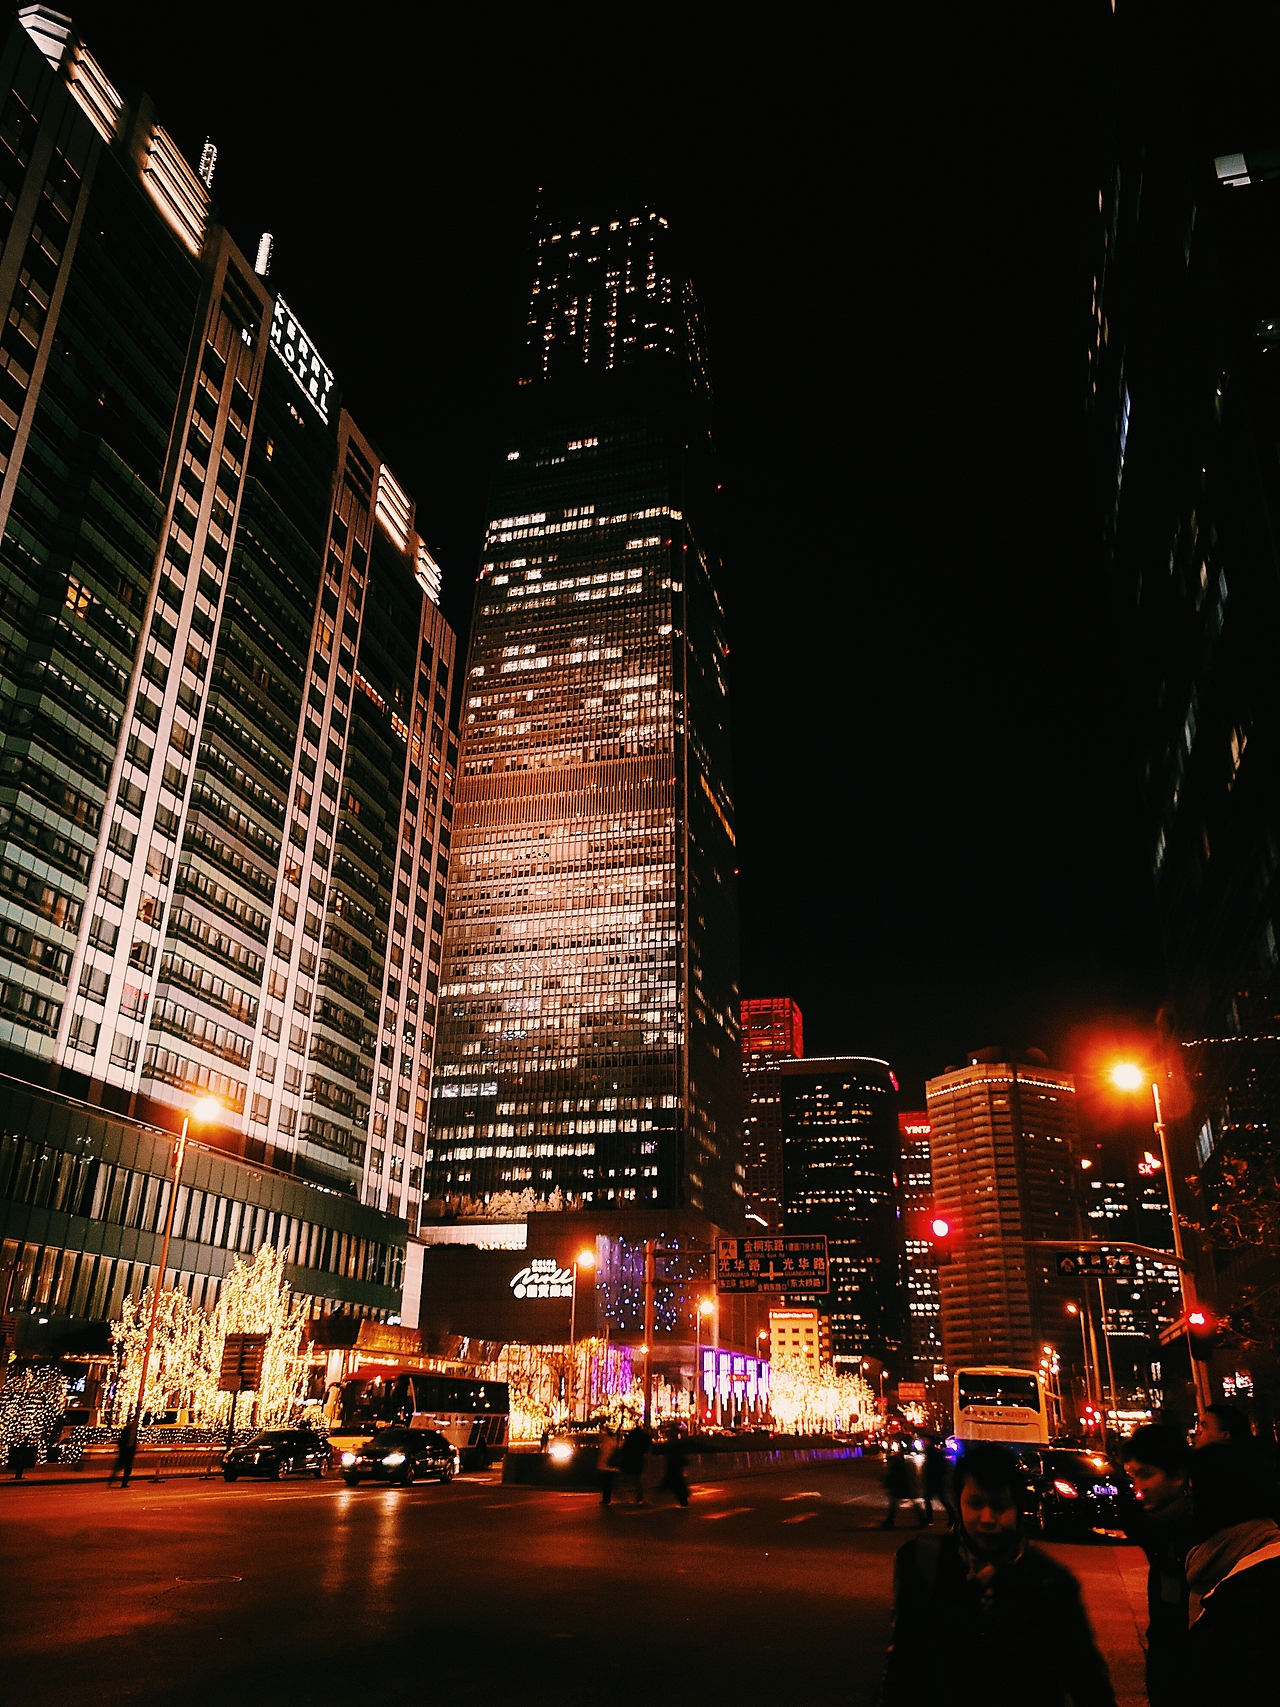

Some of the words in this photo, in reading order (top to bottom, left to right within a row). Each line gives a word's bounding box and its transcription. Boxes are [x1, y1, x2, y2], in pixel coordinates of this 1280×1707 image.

[274, 300, 334, 393] KERRY
[271, 321, 328, 413] HOTEL
[743, 1240, 784, 1253] 金桐东路
[719, 1258, 760, 1271] 光华路
[783, 1257, 825, 1271] 光华路
